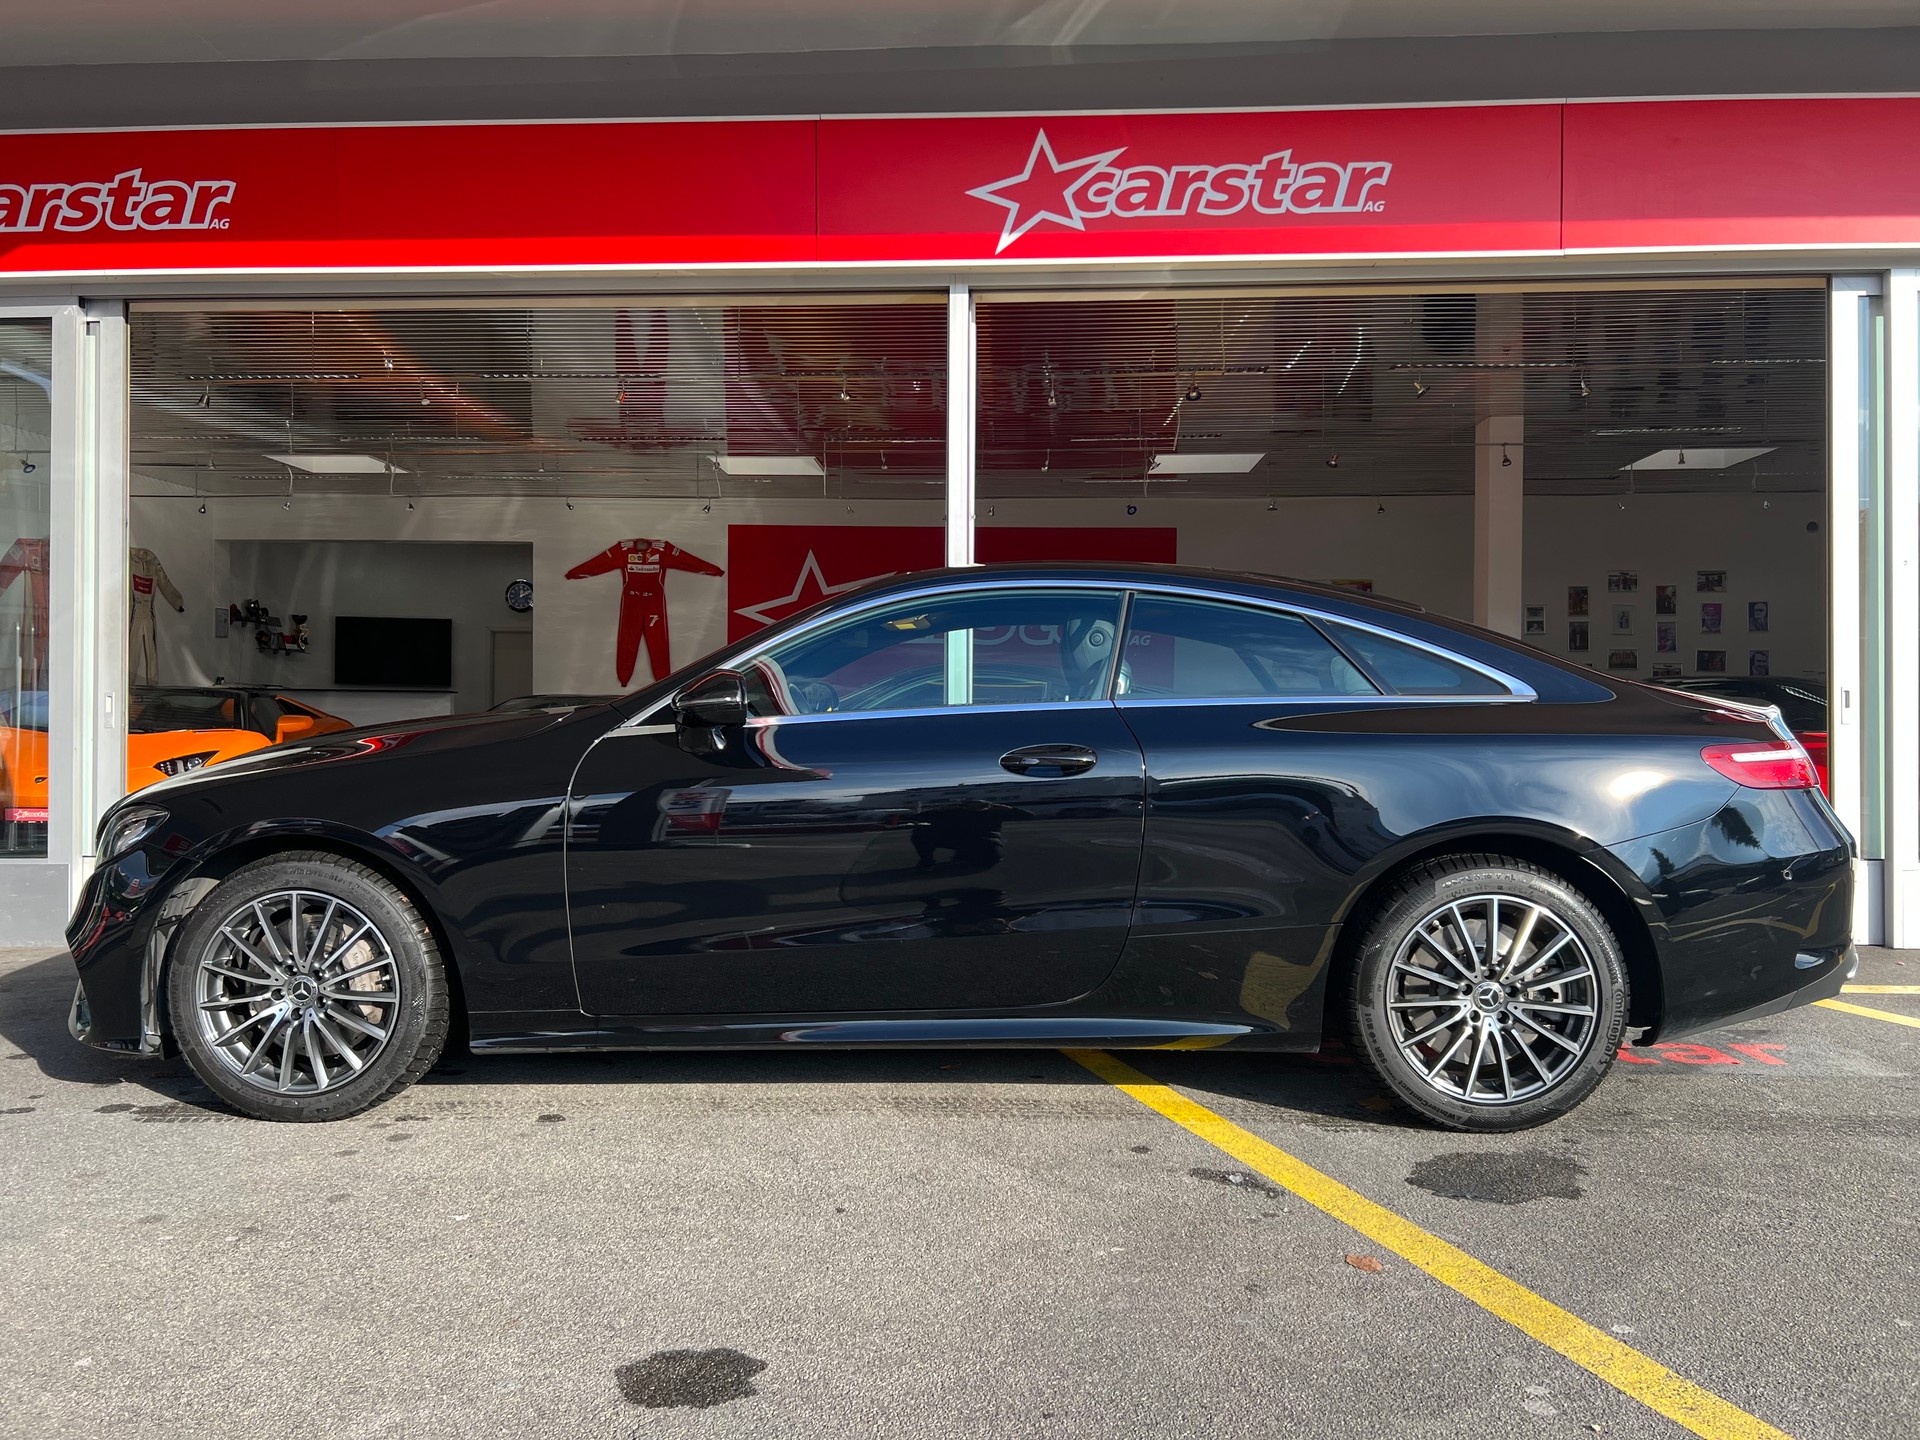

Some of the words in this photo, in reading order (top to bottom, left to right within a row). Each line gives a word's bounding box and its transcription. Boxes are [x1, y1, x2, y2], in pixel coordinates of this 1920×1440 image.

[1077, 148, 1392, 218] carstar
[1363, 201, 1385, 213] AG
[209, 218, 230, 230] AG
[649, 614, 659, 626] 7
[1129, 635, 1151, 646] AG
[1602, 987, 1624, 1057] Continental
